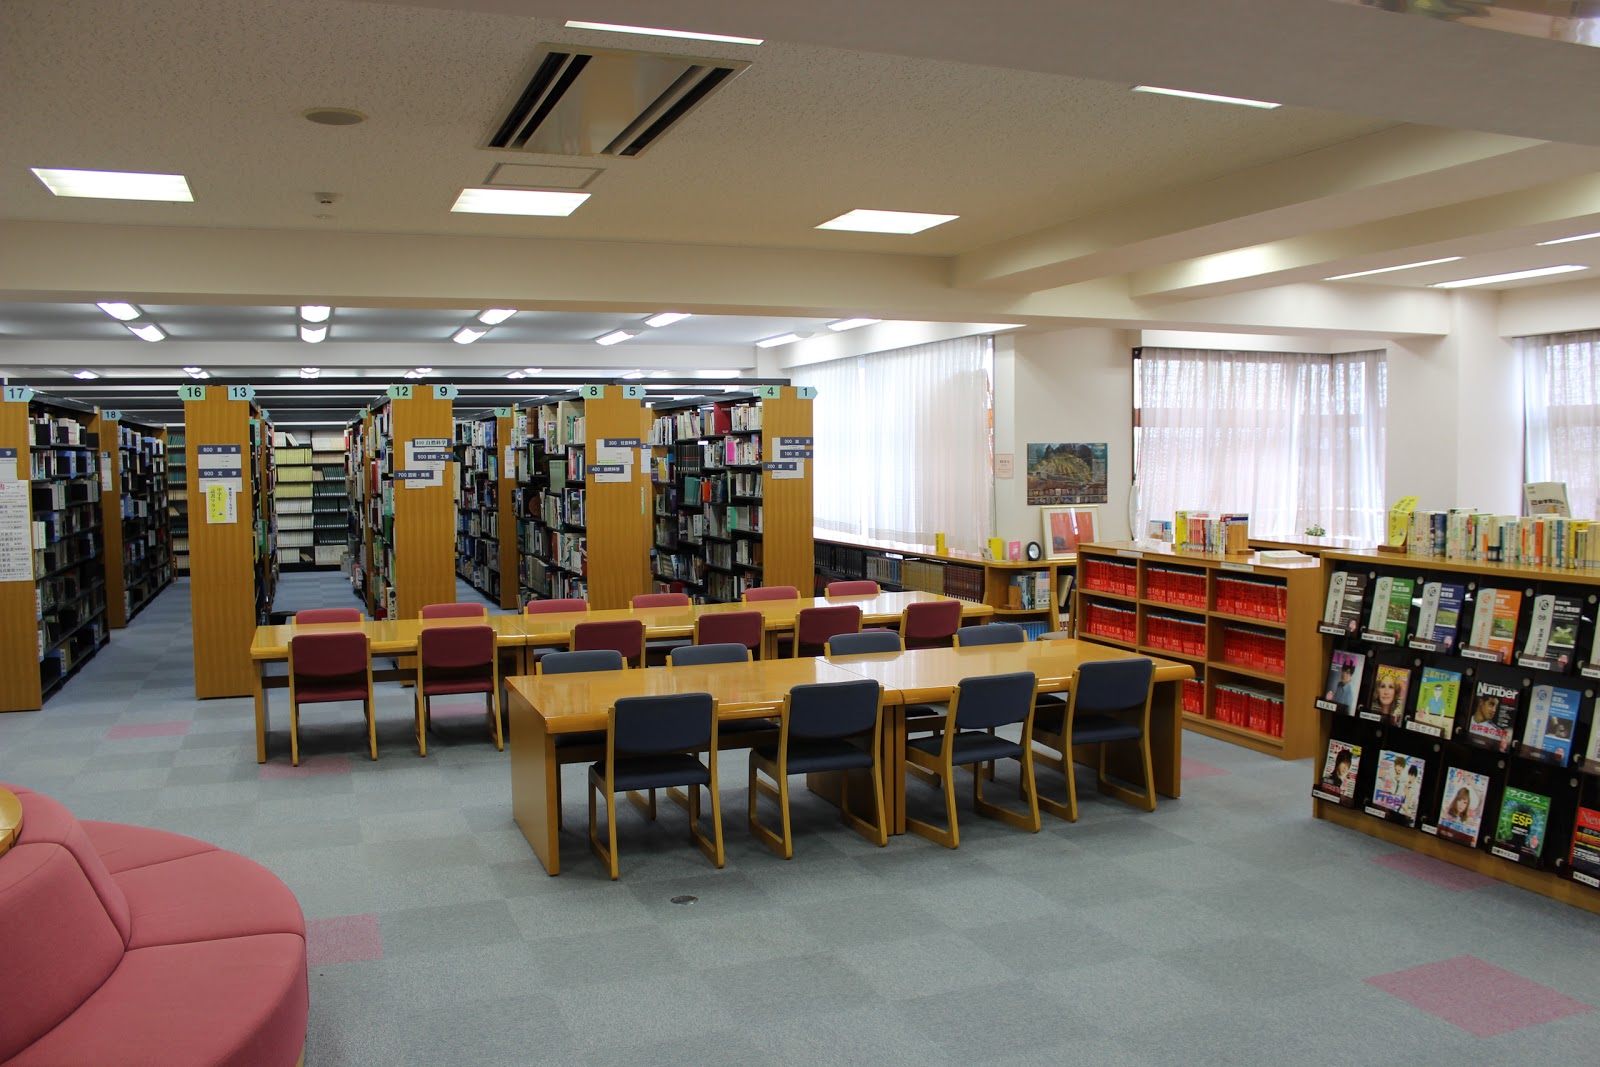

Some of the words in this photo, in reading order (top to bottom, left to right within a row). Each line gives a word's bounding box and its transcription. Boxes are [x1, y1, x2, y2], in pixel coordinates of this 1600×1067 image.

[9, 388, 24, 399] 17
[187, 387, 202, 397] 16
[233, 387, 247, 397] 13
[395, 386, 409, 396] 12
[440, 386, 448, 396] 9
[590, 386, 598, 396] 8
[629, 386, 636, 396] 5
[767, 386, 774, 396] 4
[803, 387, 808, 397] 1
[105, 411, 116, 419] 18
[1476, 681, 1519, 700] Number
[1511, 813, 1533, 827] ESP
